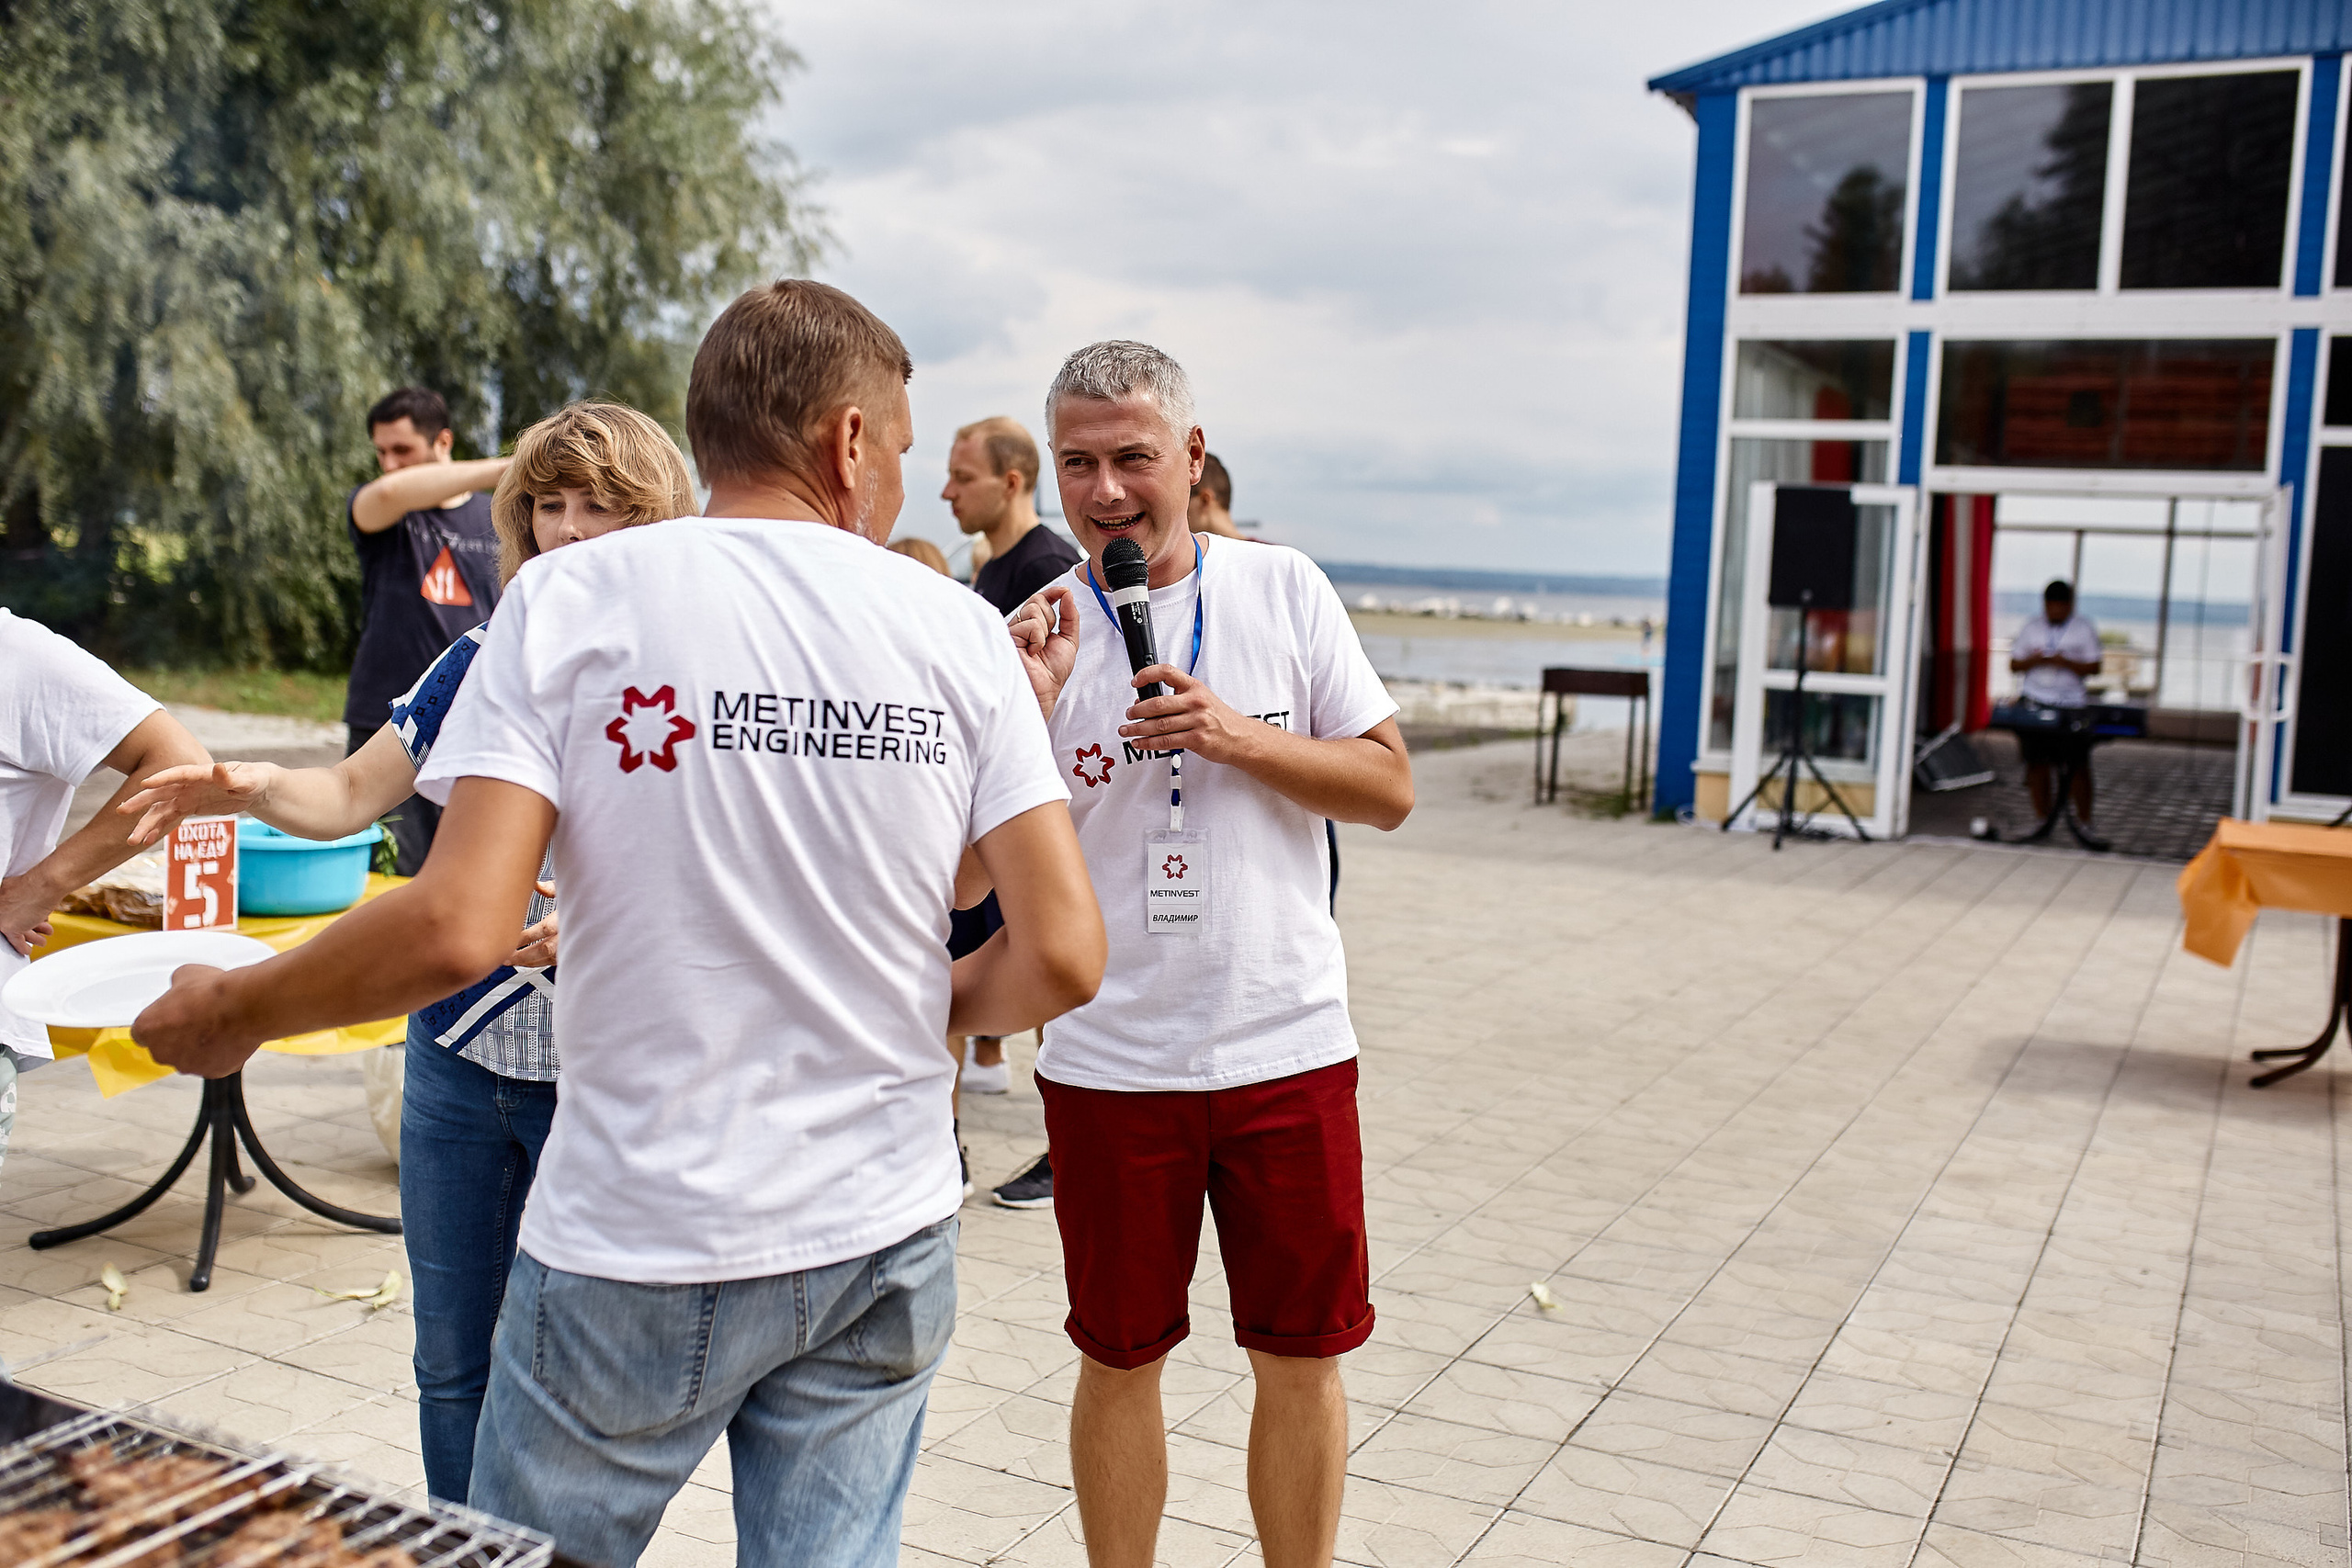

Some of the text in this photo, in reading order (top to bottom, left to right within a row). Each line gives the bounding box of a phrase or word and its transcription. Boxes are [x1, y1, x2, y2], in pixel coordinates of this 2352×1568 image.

[715, 691, 945, 738] METINVEST
[713, 724, 946, 764] ENGINEERING
[178, 823, 227, 842] ОХОТА
[175, 840, 227, 861] НА ЕДУ
[184, 860, 220, 929] 5
[1149, 889, 1200, 897] METINVEST
[1152, 914, 1199, 923] ВЛАДИМИР
